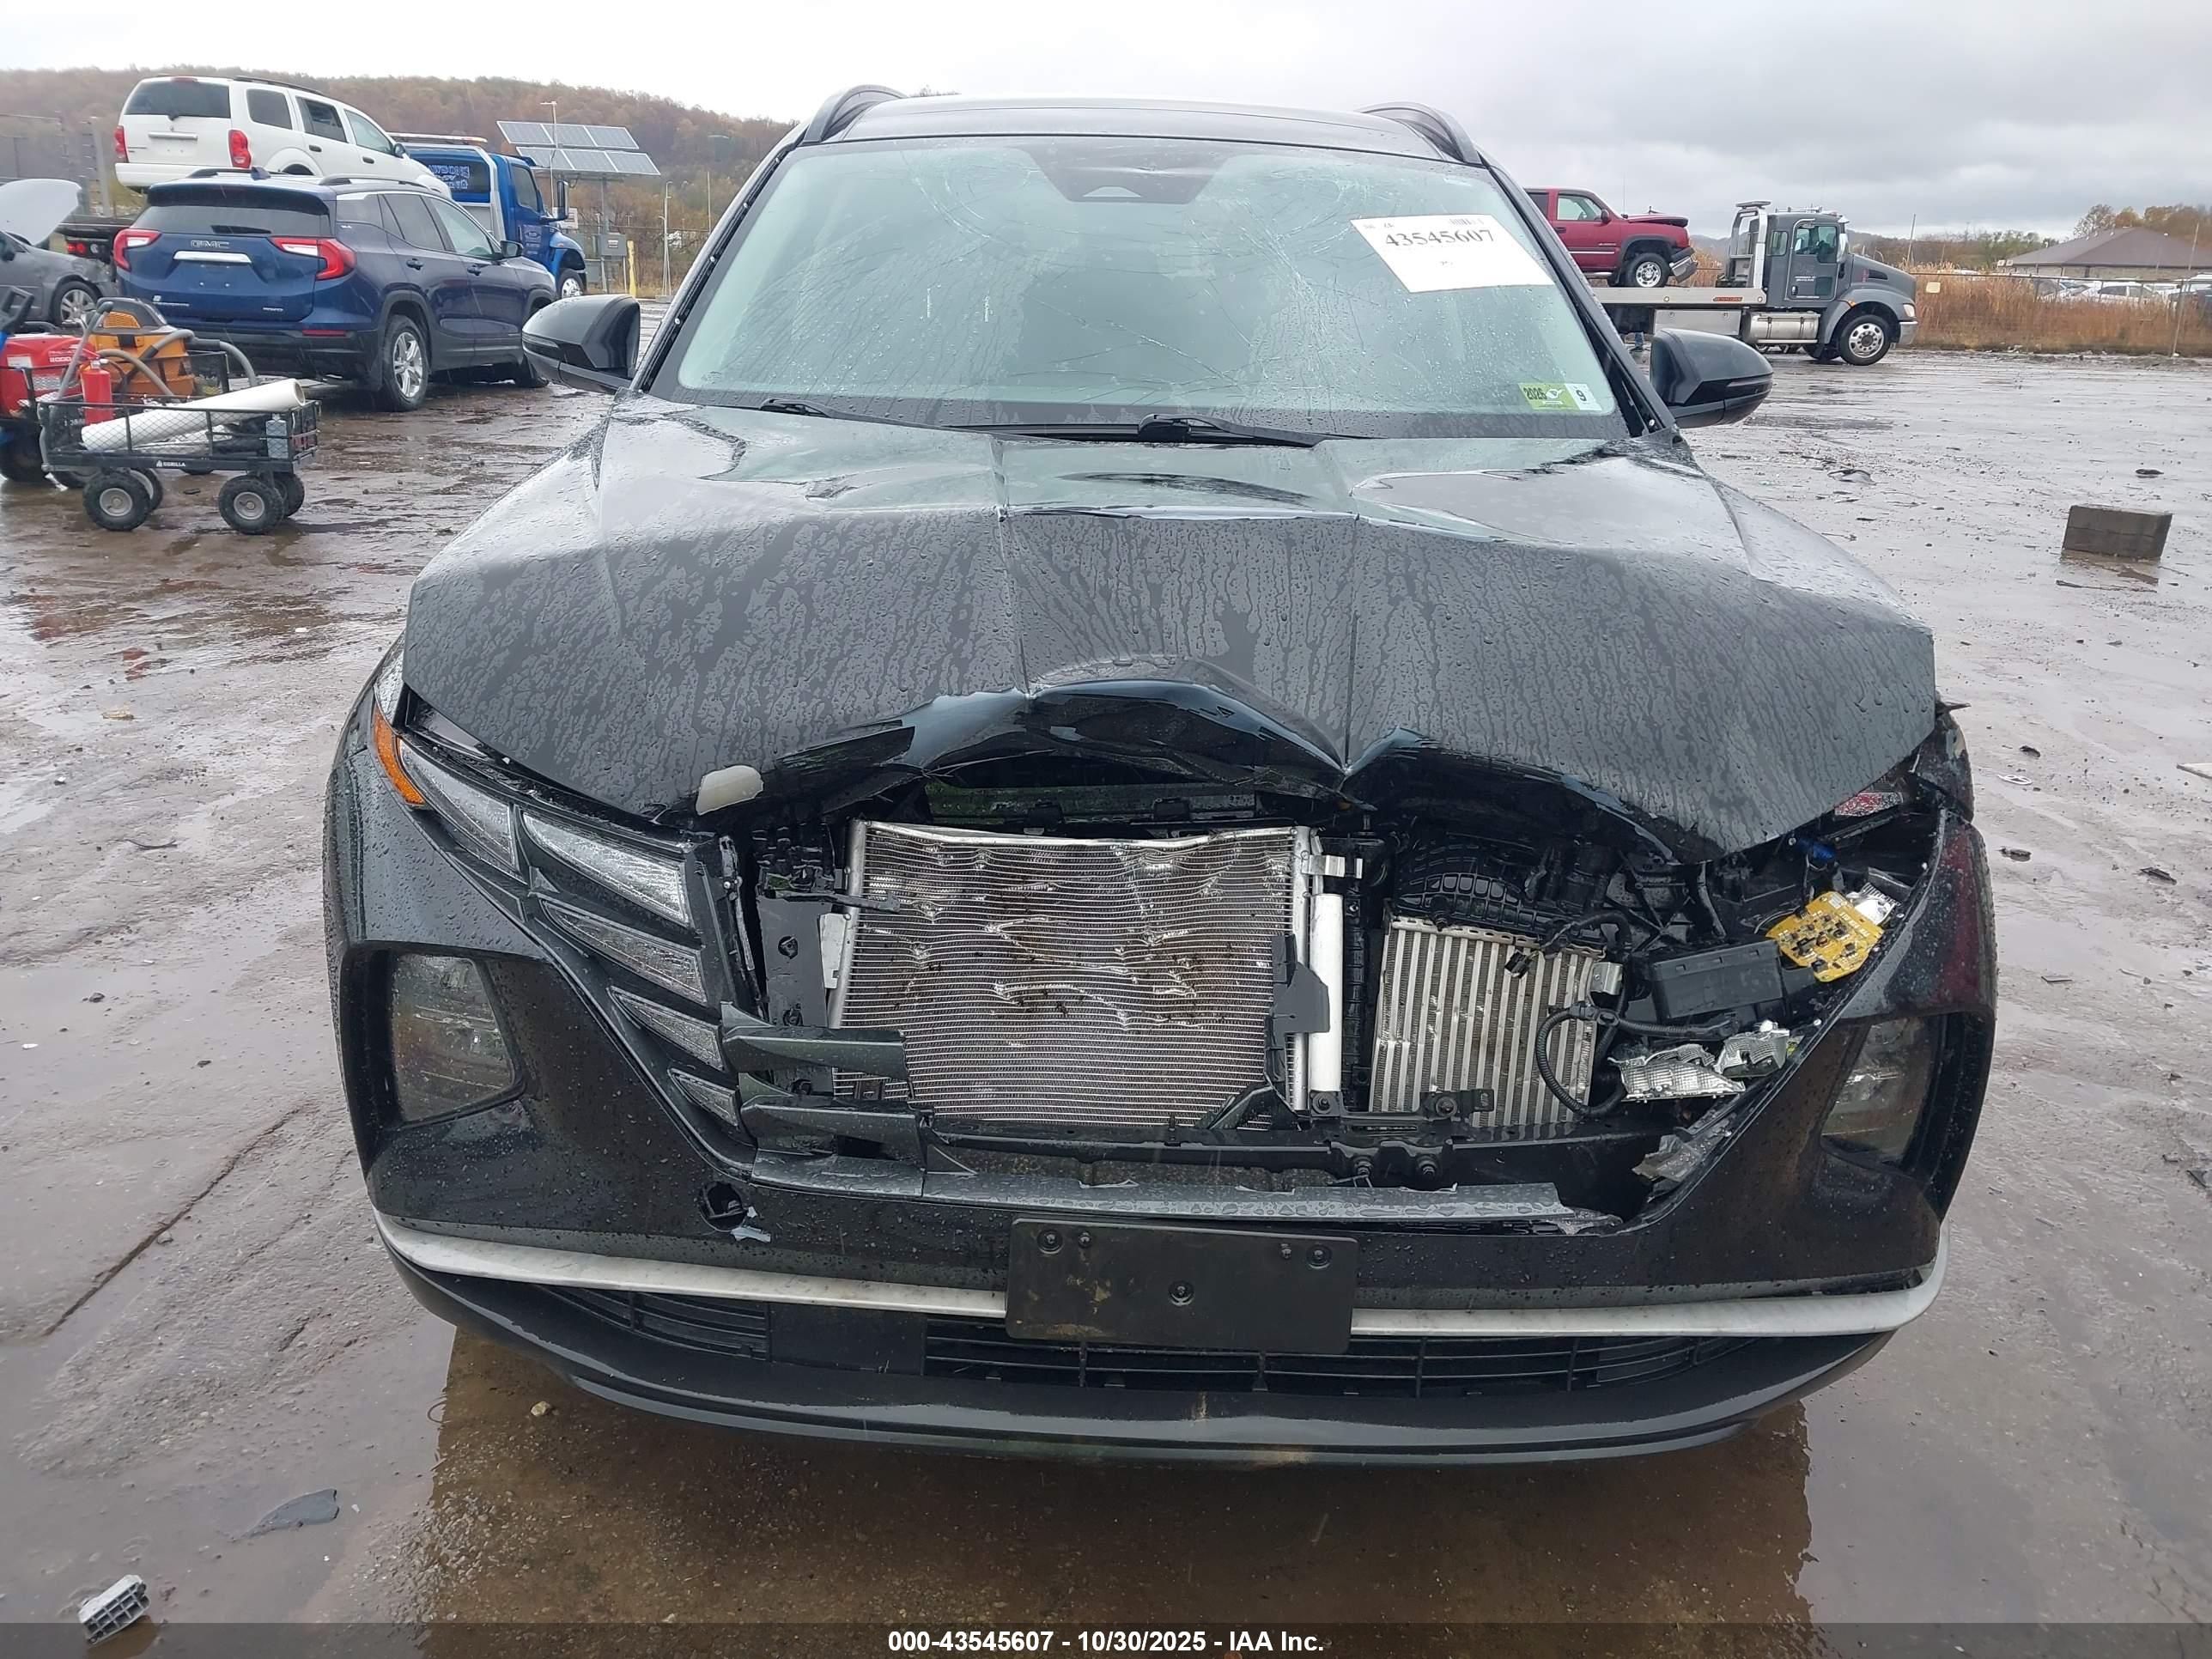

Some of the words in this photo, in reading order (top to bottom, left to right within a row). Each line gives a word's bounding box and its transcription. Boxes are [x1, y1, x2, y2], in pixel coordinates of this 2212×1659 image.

[191, 240, 230, 250] GMC
[1385, 229, 1495, 246] 43545607
[1523, 386, 1547, 400] 2026
[1576, 389, 1588, 402] 9
